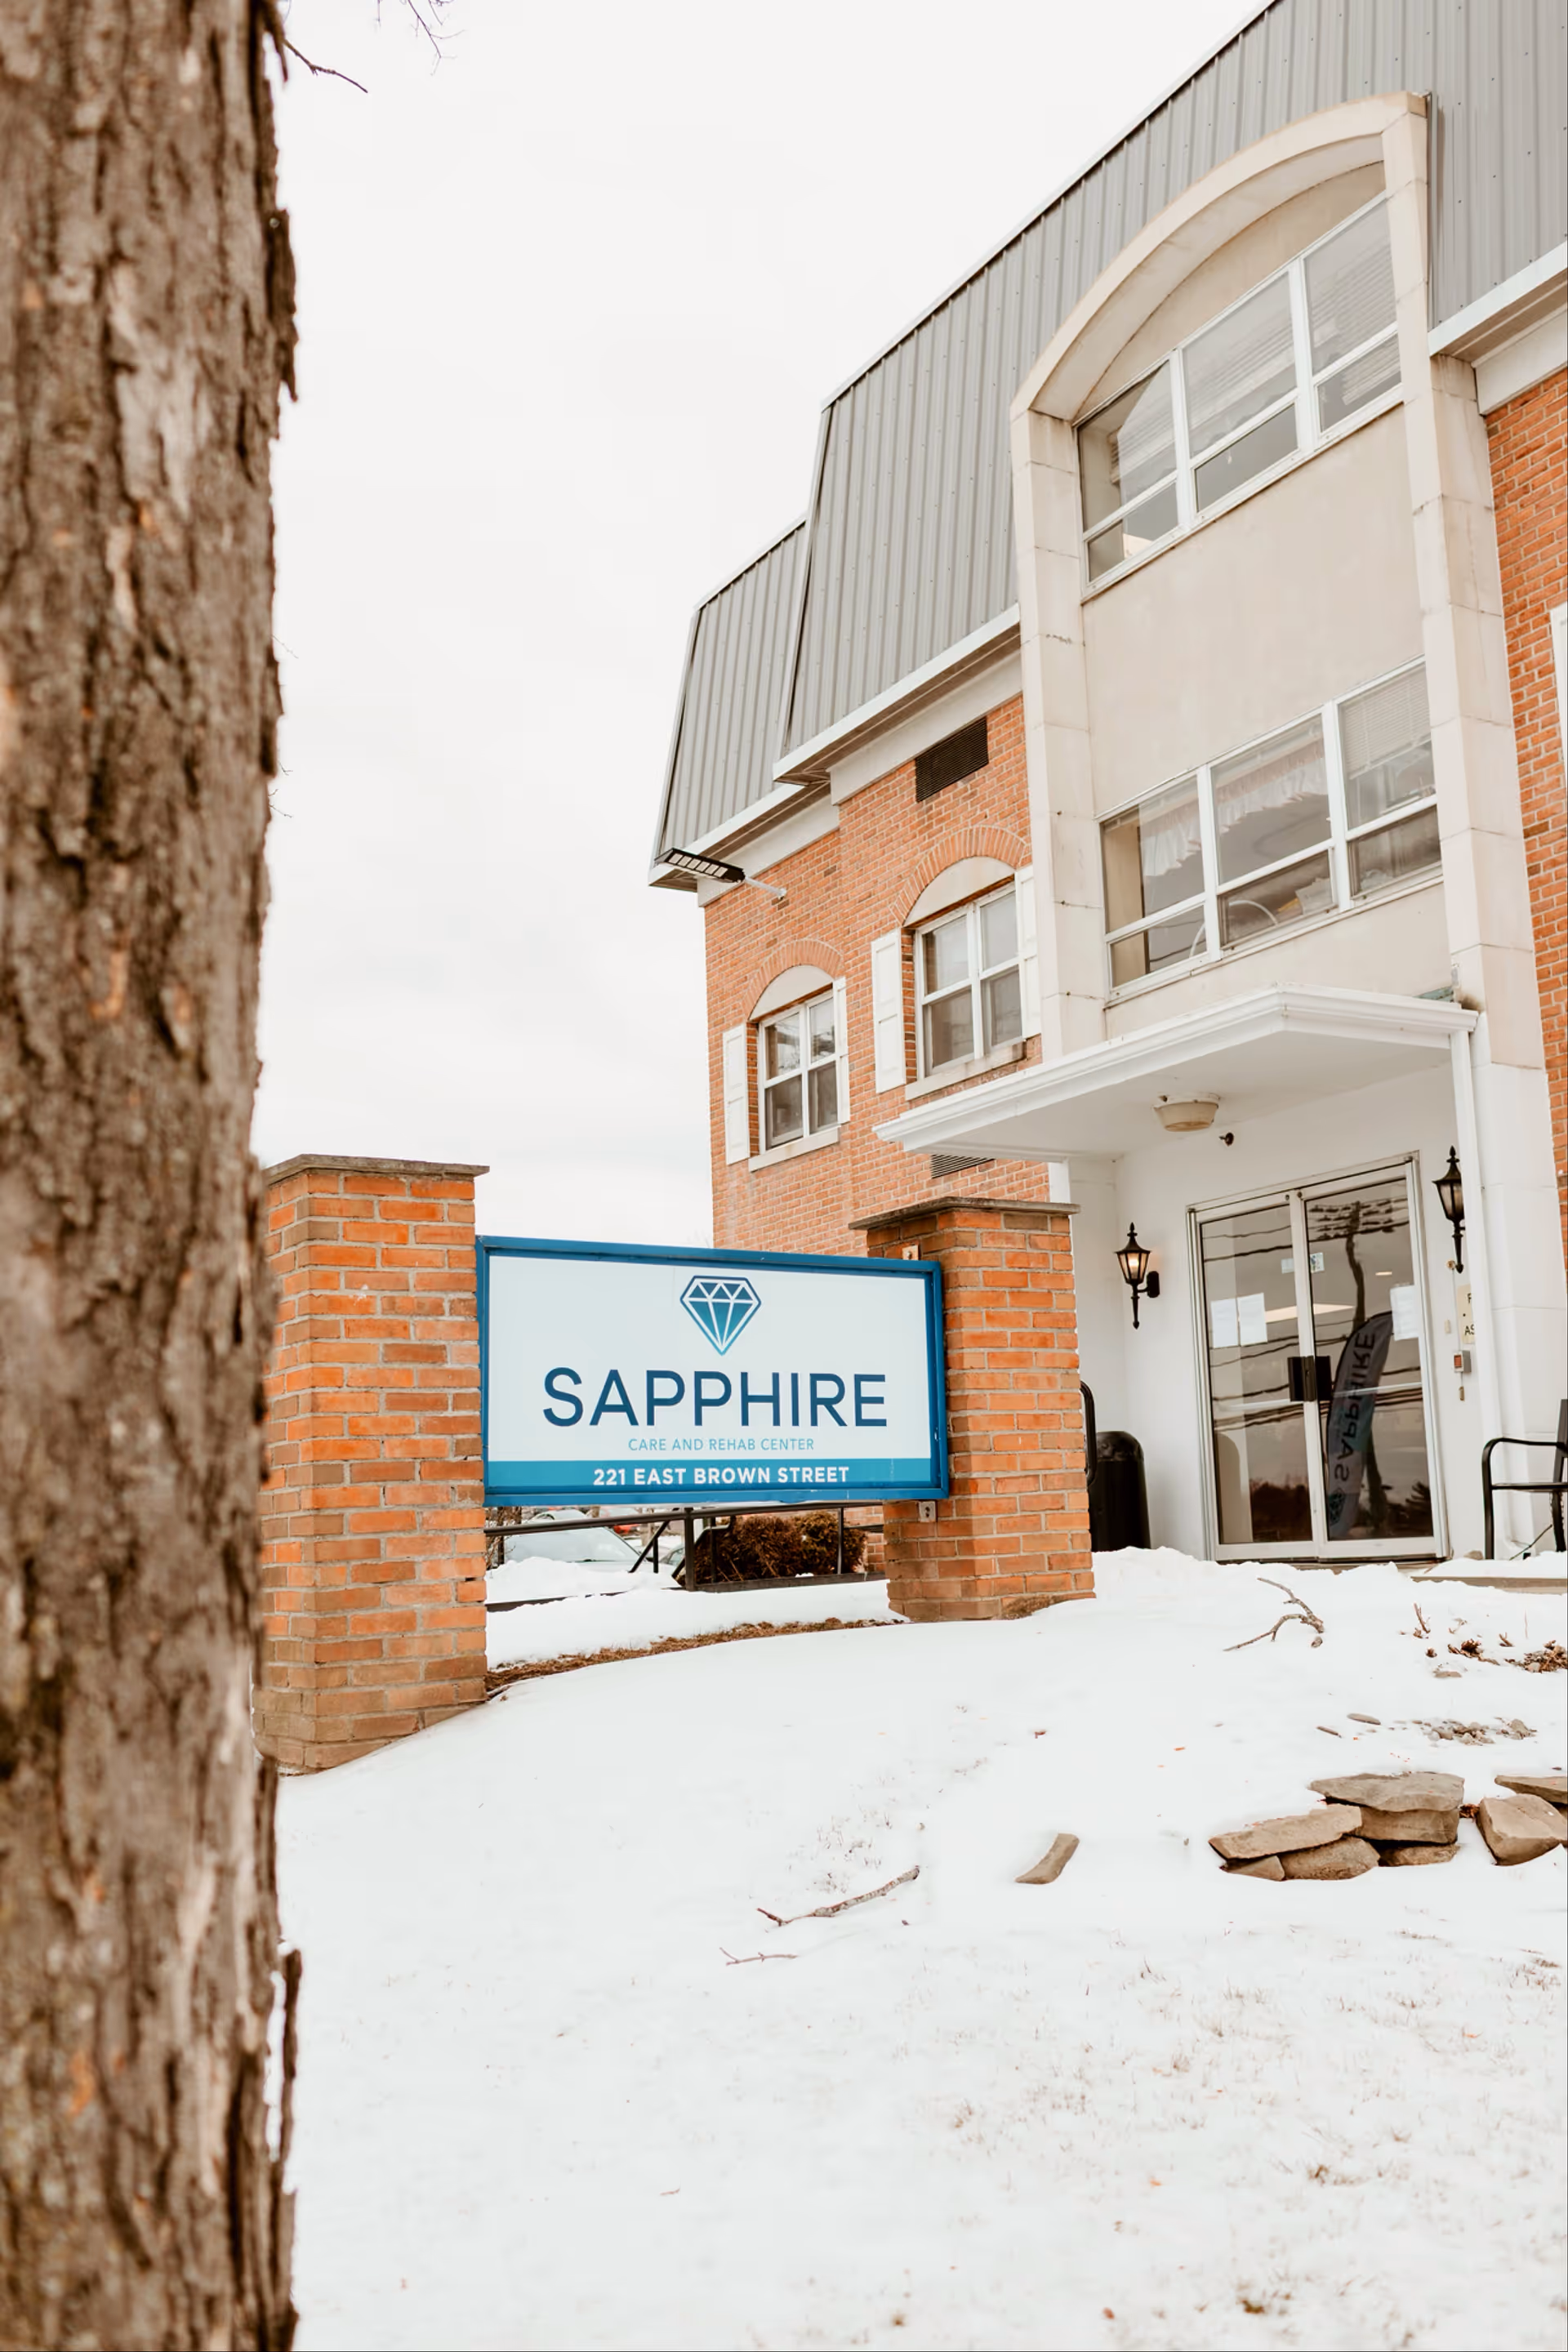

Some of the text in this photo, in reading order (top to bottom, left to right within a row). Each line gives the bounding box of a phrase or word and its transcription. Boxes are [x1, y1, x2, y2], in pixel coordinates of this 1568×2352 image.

[542, 1366, 888, 1428] SAPPHIRE
[628, 1437, 815, 1451] CARE AND REHAB CENTER
[593, 1467, 849, 1486] 221 EAST BROWN STREET
